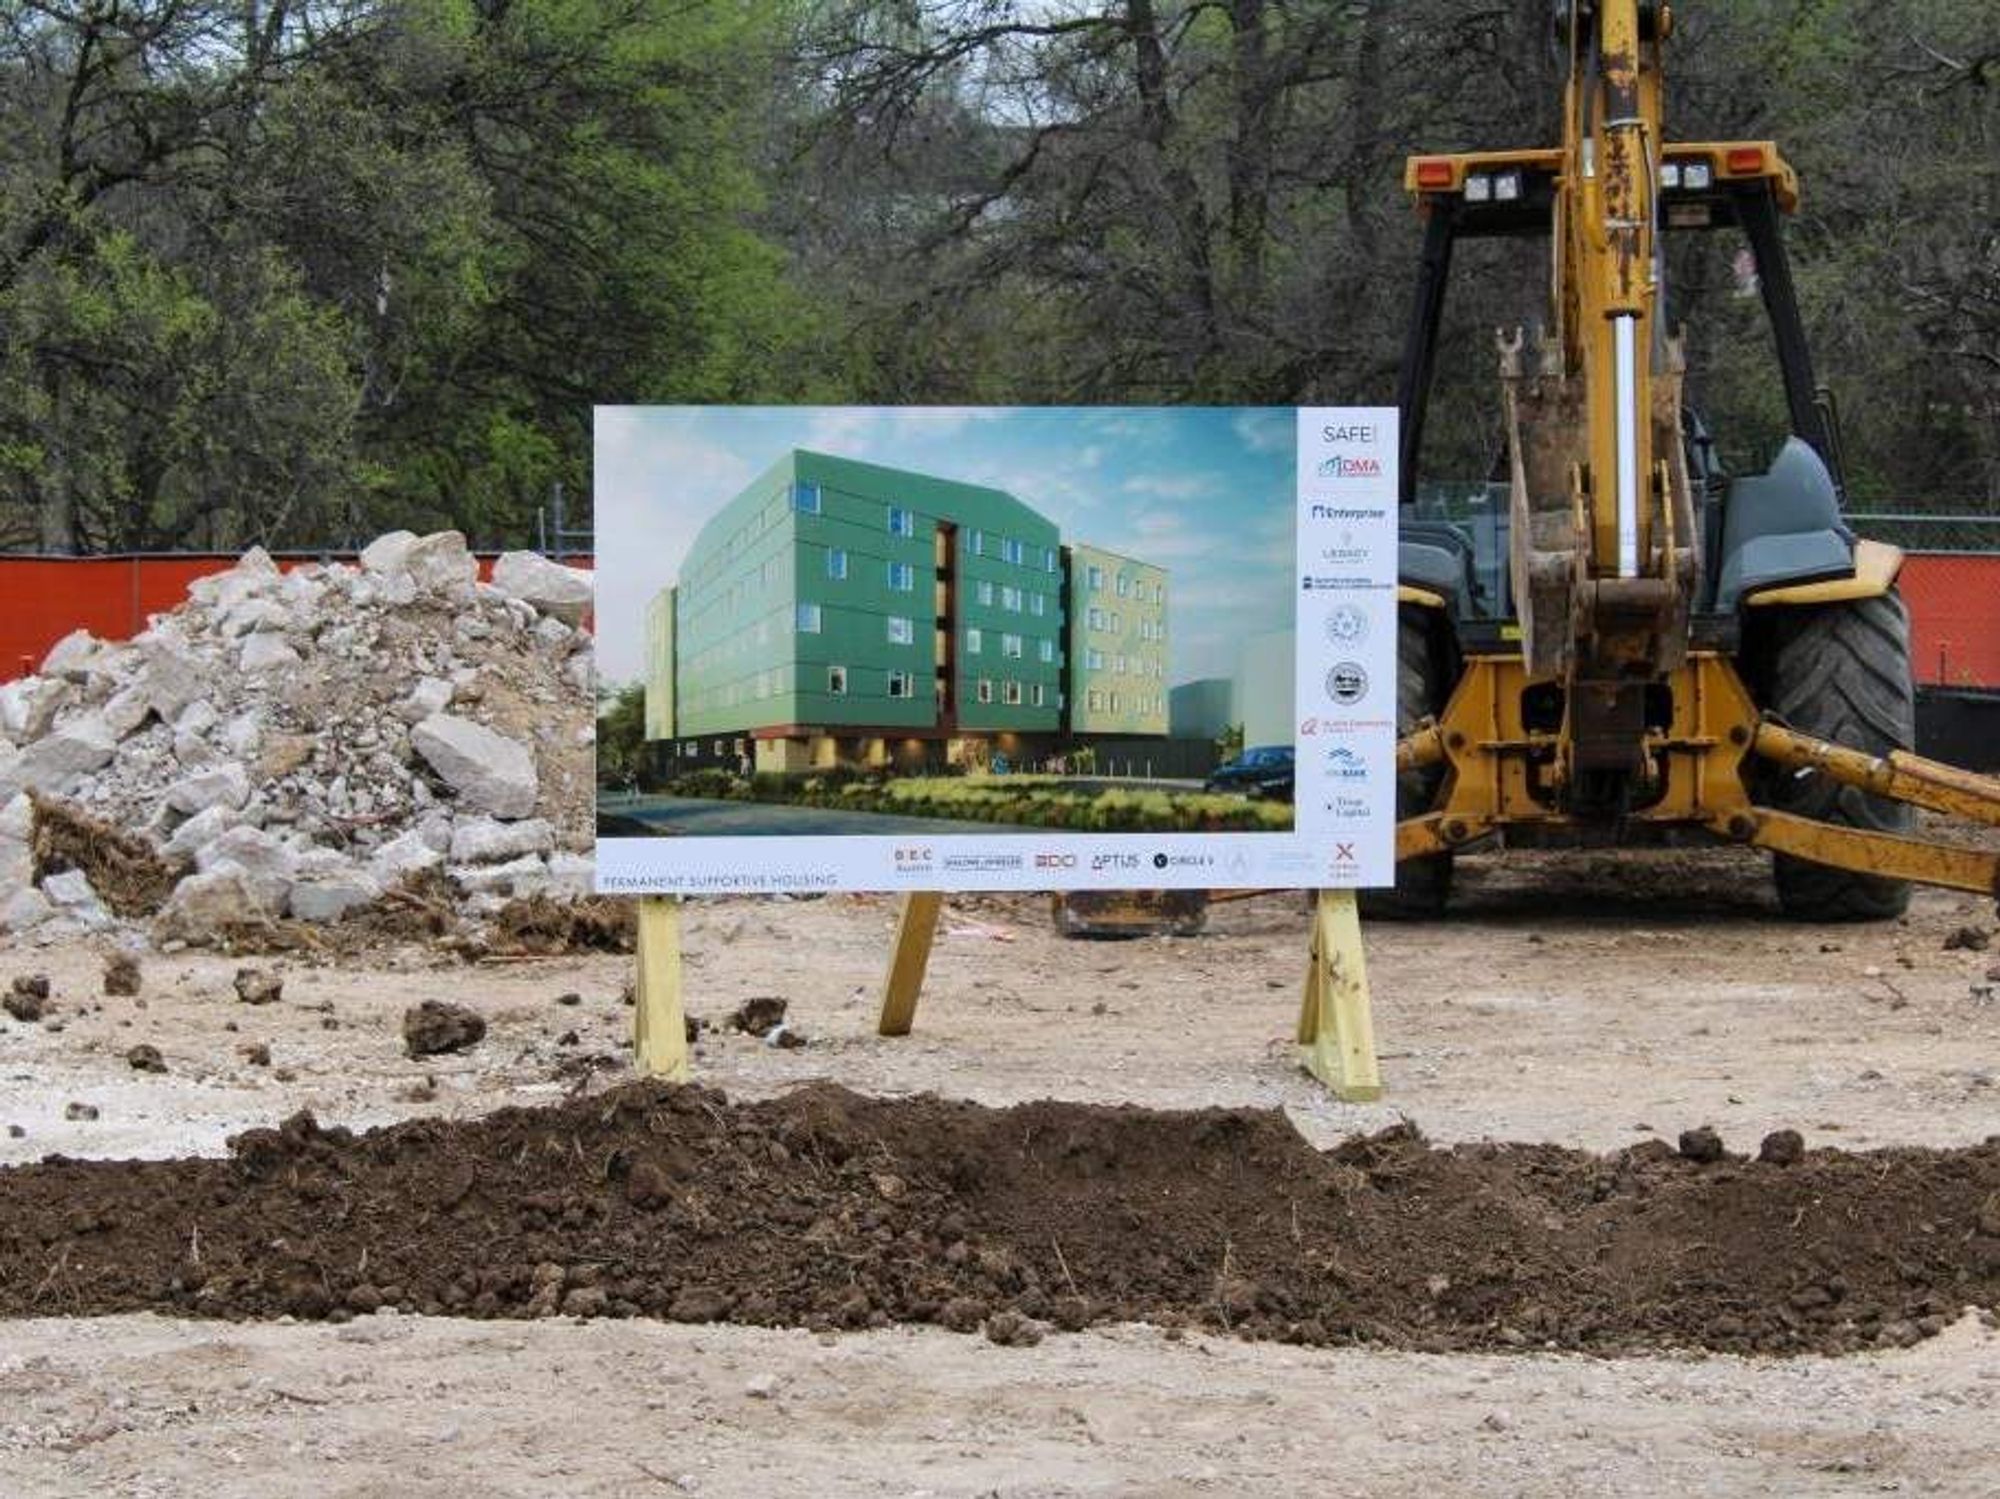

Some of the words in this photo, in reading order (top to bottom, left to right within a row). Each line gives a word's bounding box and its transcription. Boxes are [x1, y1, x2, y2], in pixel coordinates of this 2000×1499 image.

[1323, 426, 1372, 442] SAFE
[603, 876, 683, 888] PERMANENT
[689, 875, 765, 887] SUPPORTIVE
[771, 874, 838, 886] HOUSING
